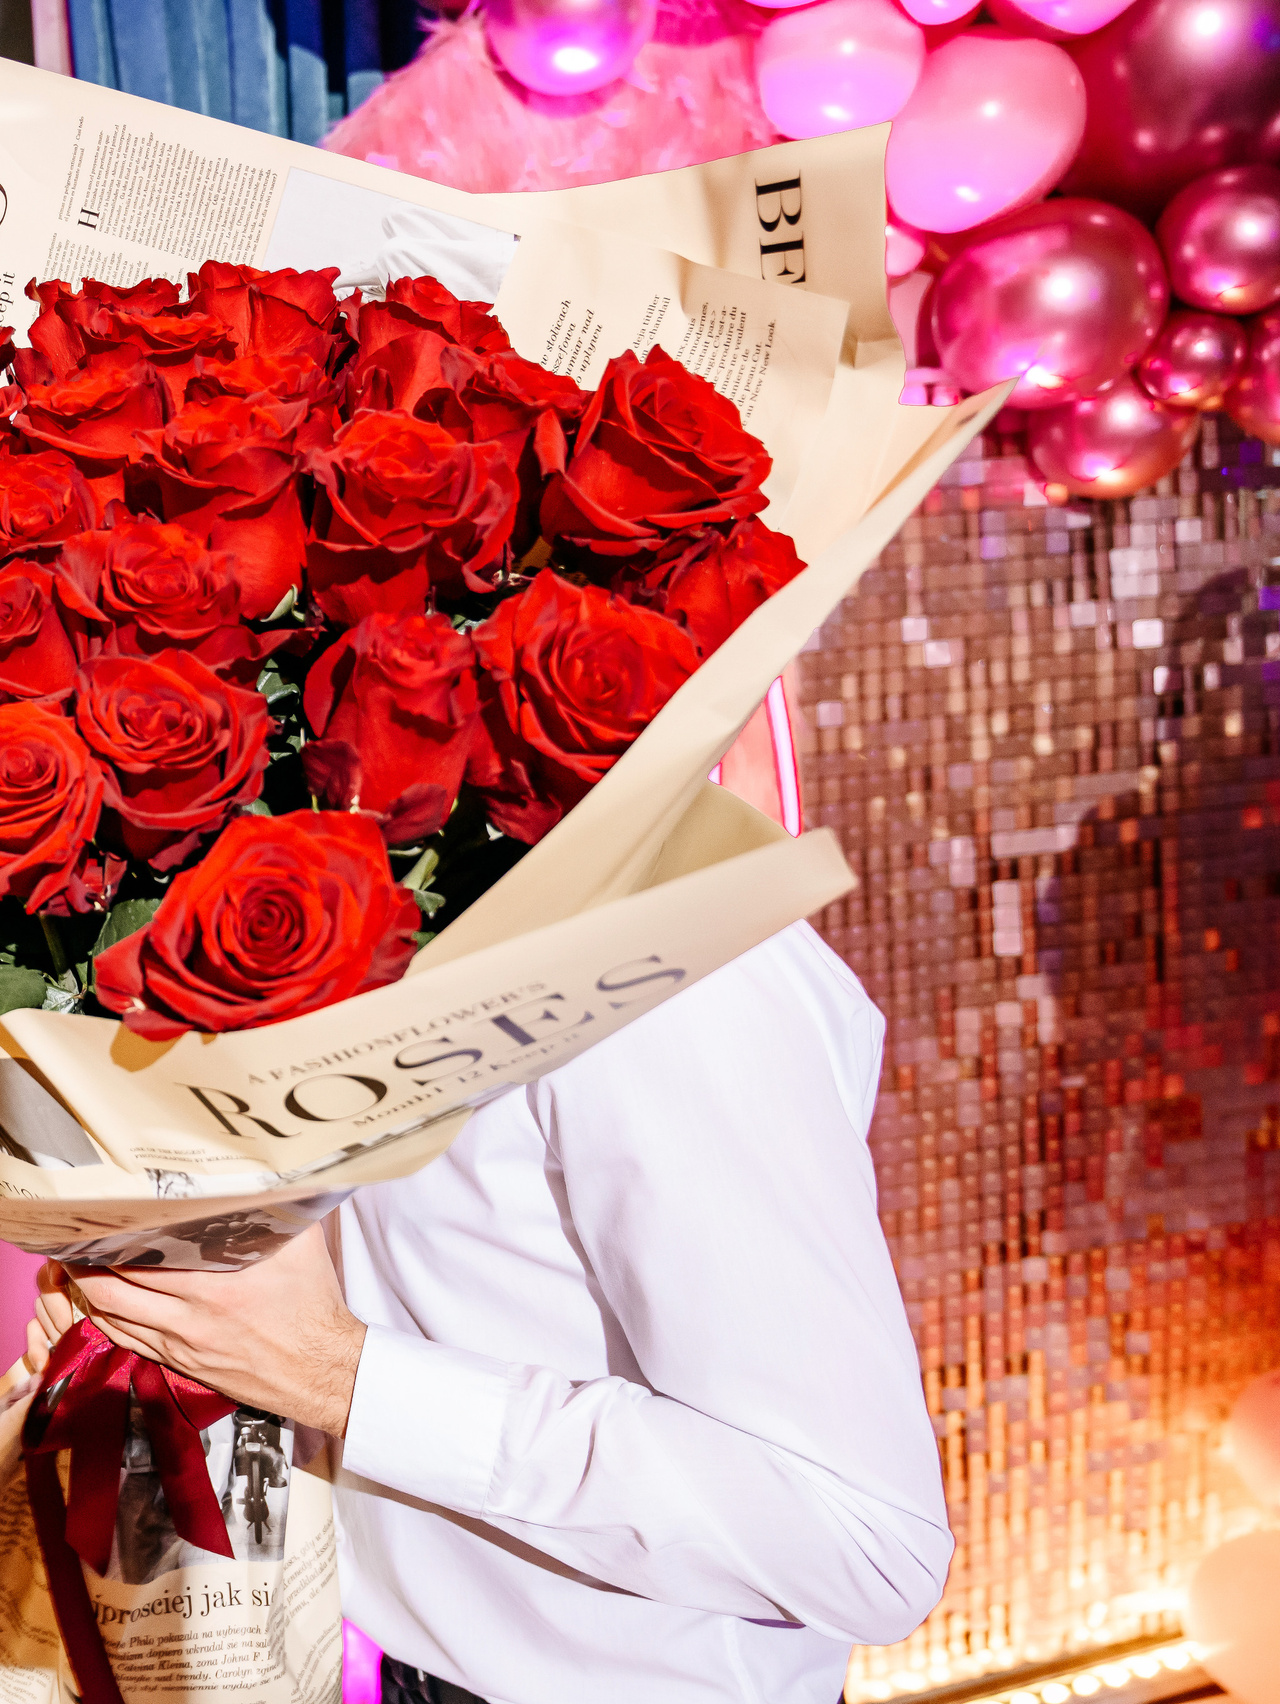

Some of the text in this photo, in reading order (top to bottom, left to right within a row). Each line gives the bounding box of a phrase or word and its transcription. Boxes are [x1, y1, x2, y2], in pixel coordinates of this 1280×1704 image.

[581, 309, 594, 334] nad
[676, 318, 696, 359] ux,mais
[693, 341, 710, 374] xistait
[749, 378, 763, 402] New
[759, 351, 770, 375] New
[175, 954, 687, 1140] ROSES
[201, 1582, 243, 1618] jak
